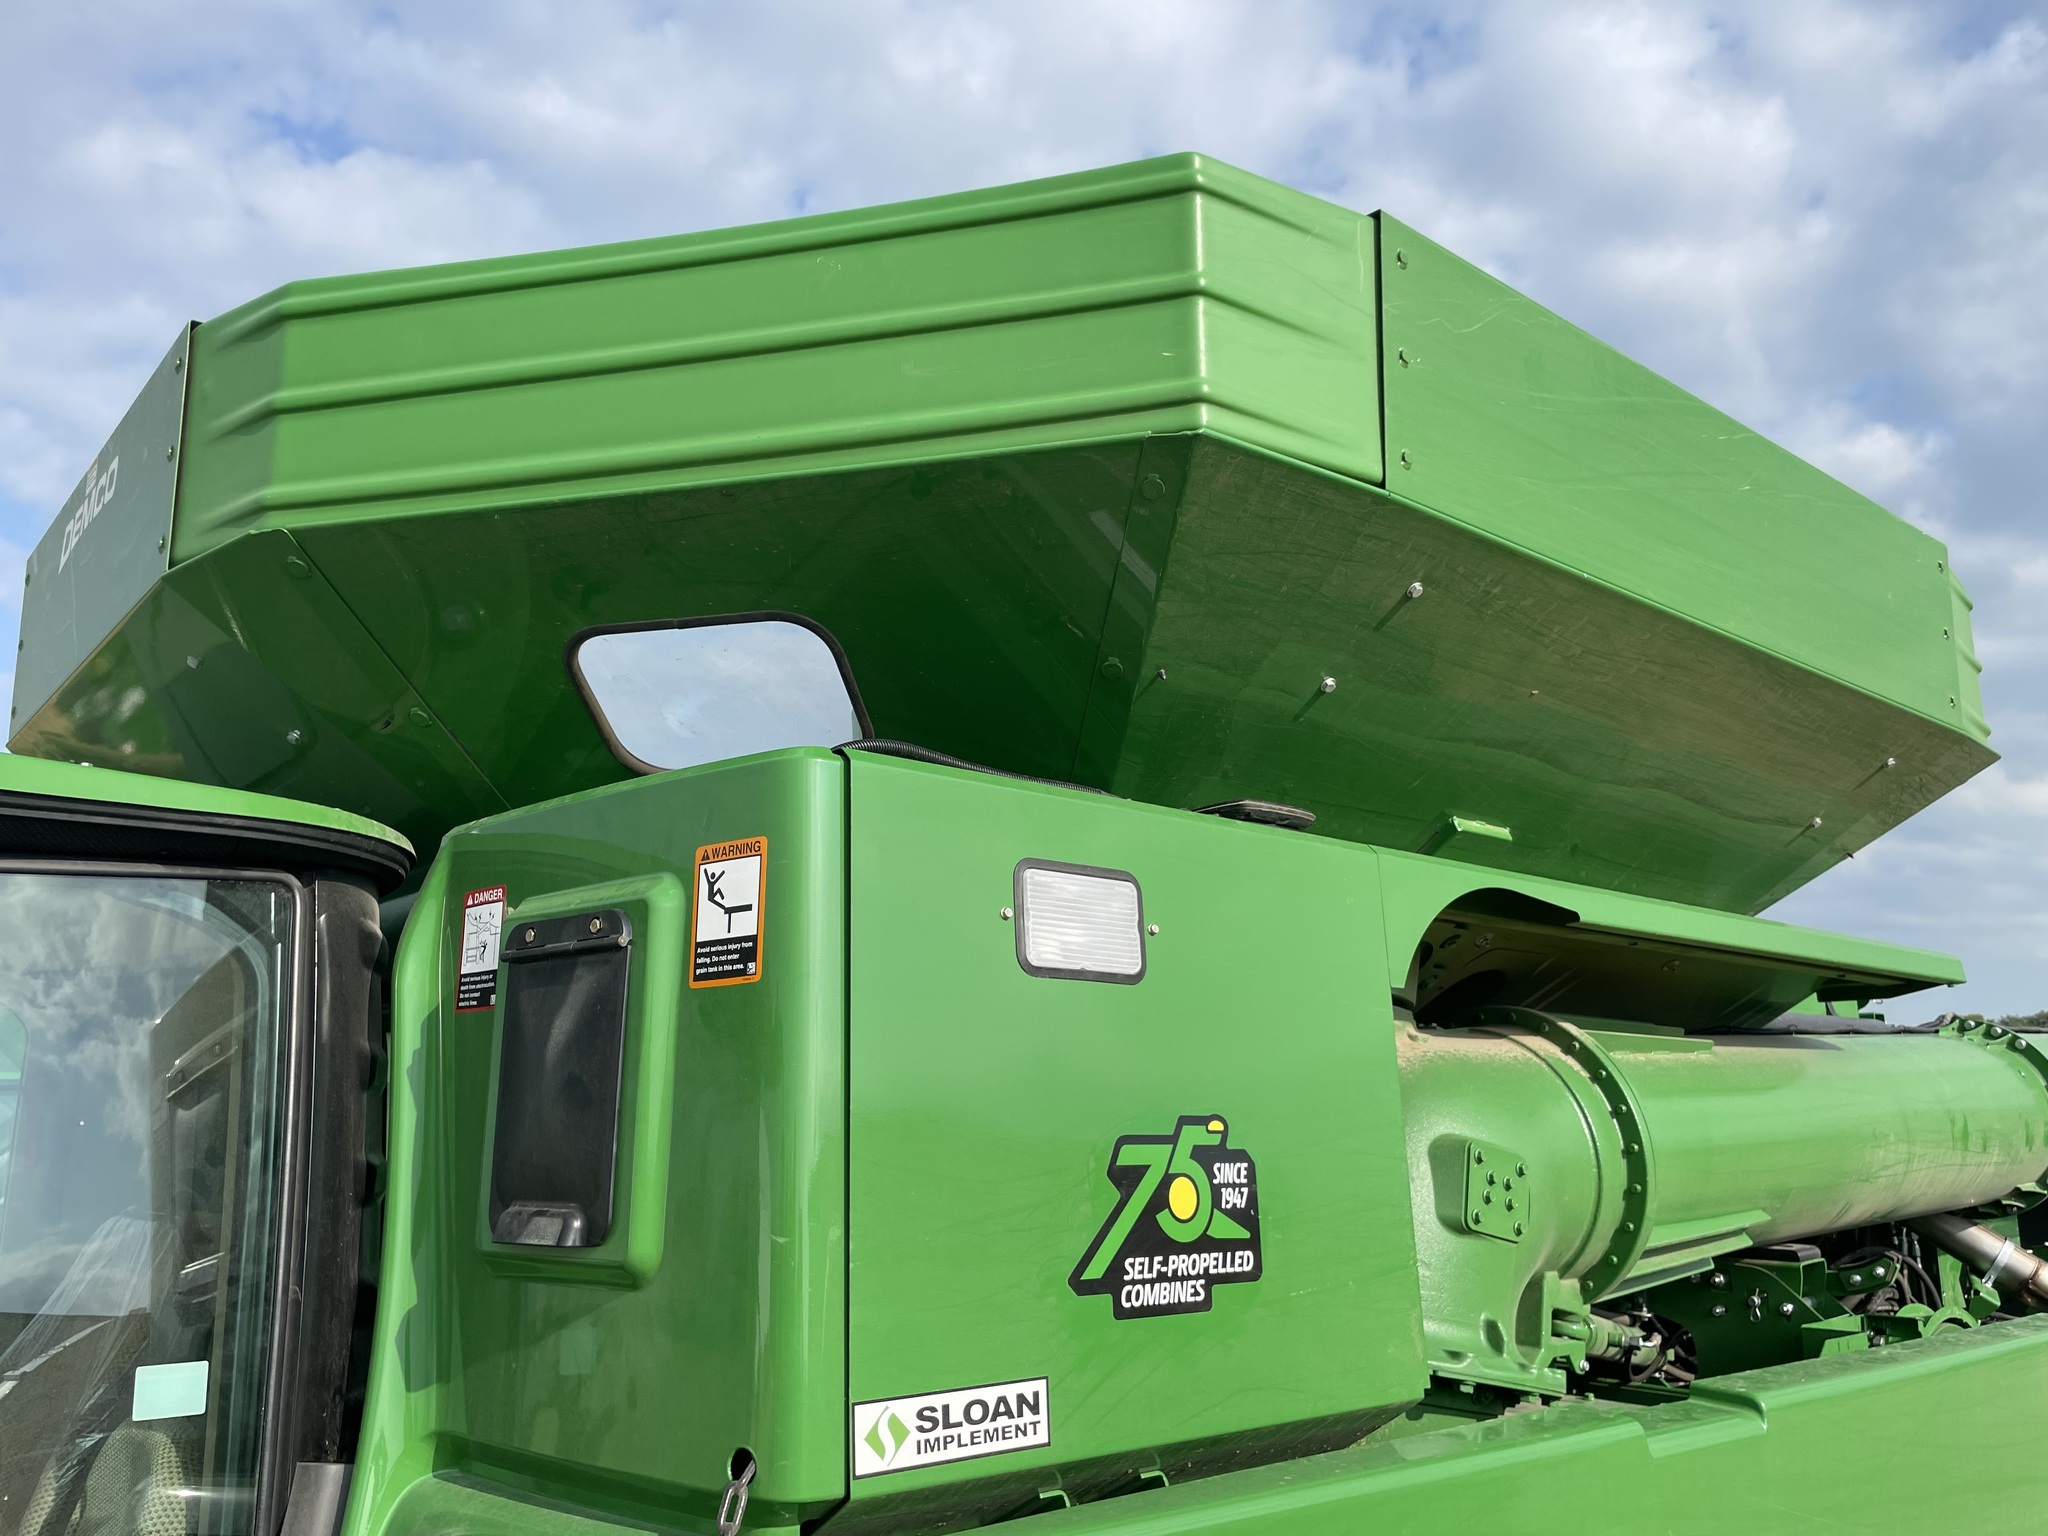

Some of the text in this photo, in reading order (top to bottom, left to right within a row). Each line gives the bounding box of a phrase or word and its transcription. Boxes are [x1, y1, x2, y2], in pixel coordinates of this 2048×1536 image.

[58, 455, 119, 575] DEMCO
[711, 840, 762, 860] WARNING
[474, 888, 503, 904] DANGER
[697, 946, 711, 954] Avoid
[707, 964, 718, 972] tank
[718, 963, 723, 971] in
[723, 962, 733, 971] this
[1212, 1162, 1248, 1184] SINCE
[1080, 1124, 1222, 1280] 75
[1220, 1187, 1248, 1209] 1947
[1123, 1250, 1254, 1281] SELF-PROPELLED
[1121, 1279, 1205, 1308] COMBINES
[915, 1390, 1040, 1434] SLOAN
[916, 1420, 1041, 1455] IMPLEMENT
